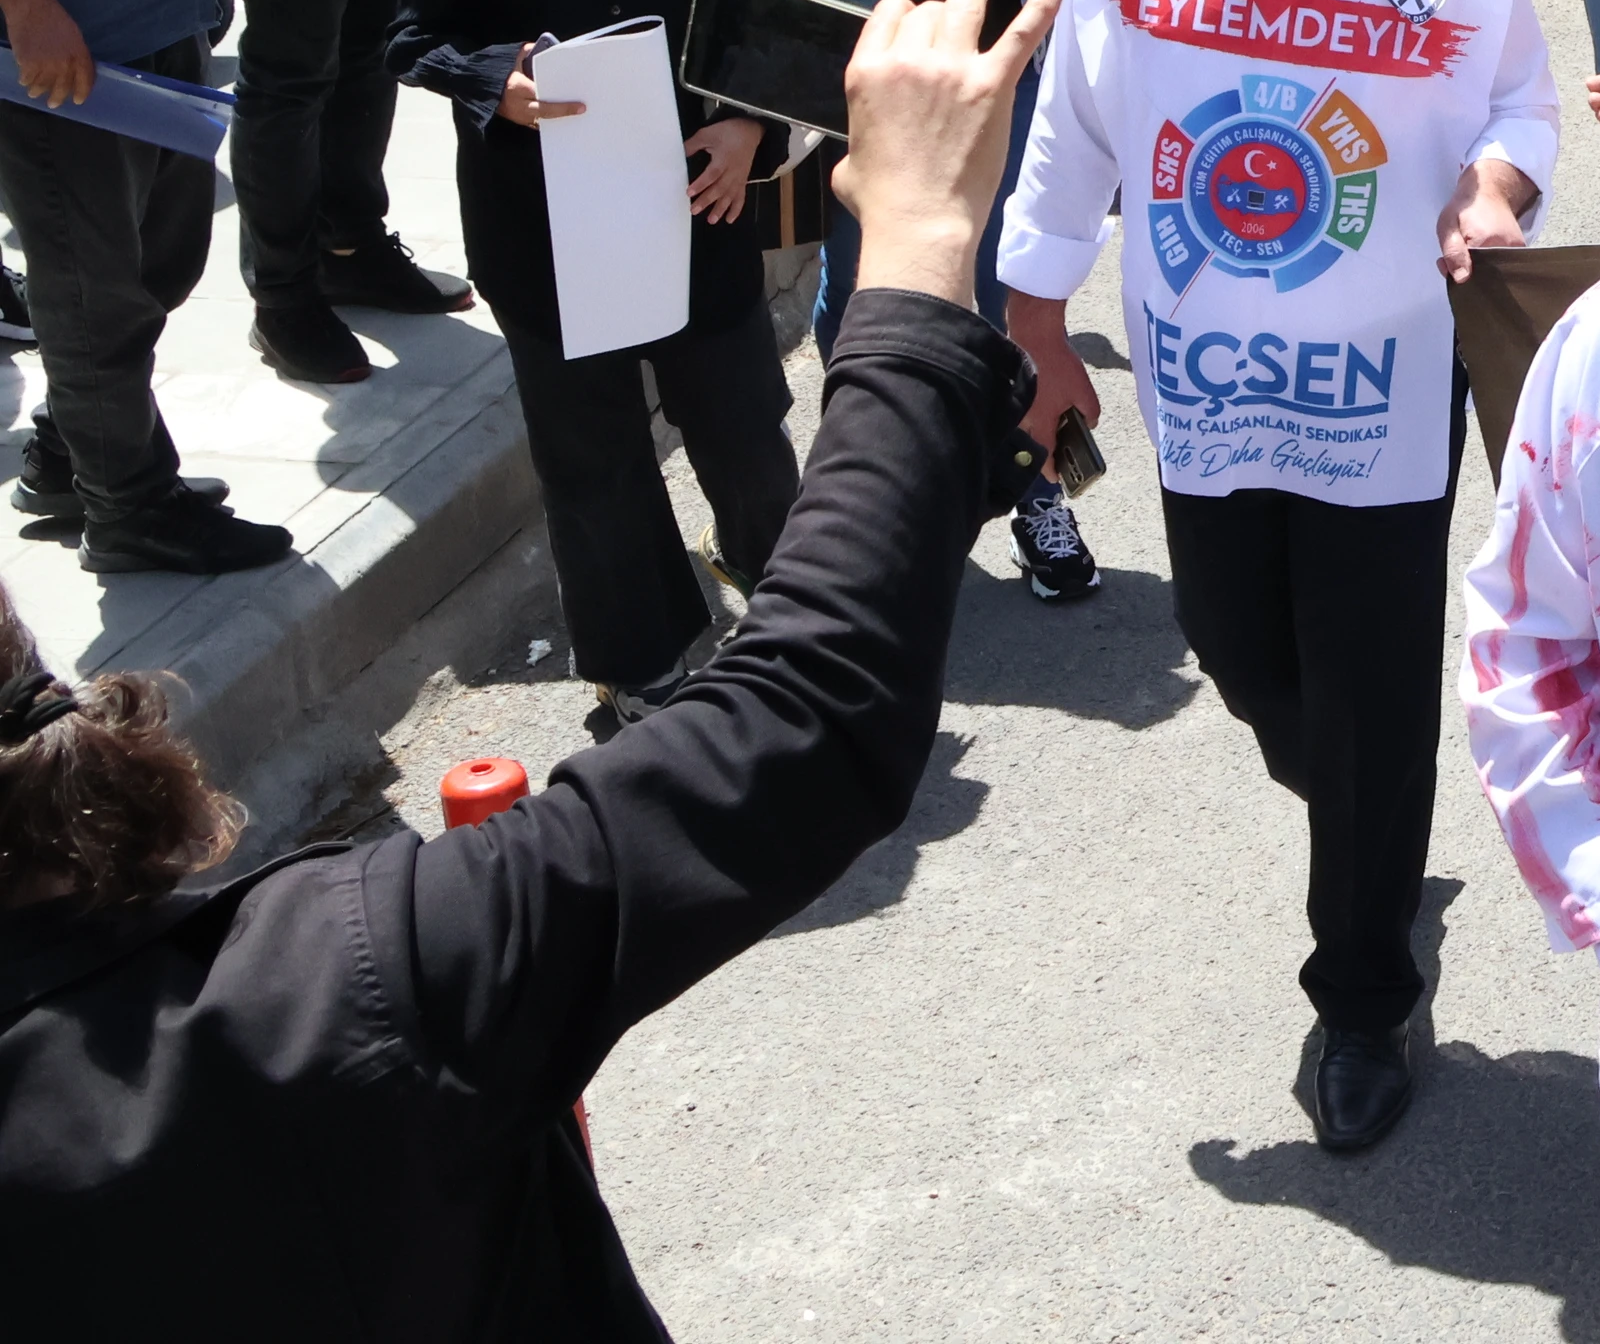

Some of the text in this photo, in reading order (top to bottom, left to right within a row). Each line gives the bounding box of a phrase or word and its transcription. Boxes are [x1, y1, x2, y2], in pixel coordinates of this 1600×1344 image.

[1253, 80, 1298, 112] 4/B
[1194, 170, 1208, 197] TÜM
[1233, 127, 1303, 157] ÇALIŞANLARI
[1319, 108, 1370, 164] YHS
[1155, 138, 1183, 192] SHS
[1241, 221, 1265, 236] 2006
[1336, 181, 1372, 235] THS
[1155, 214, 1190, 268] GİH
[1218, 229, 1243, 256] TEÇ
[1256, 239, 1284, 256] SEN
[1196, 414, 1301, 436] ÇALIŞANLARI
[1199, 436, 1265, 478] Daha
[1270, 438, 1382, 487] Güçlüyüz!
